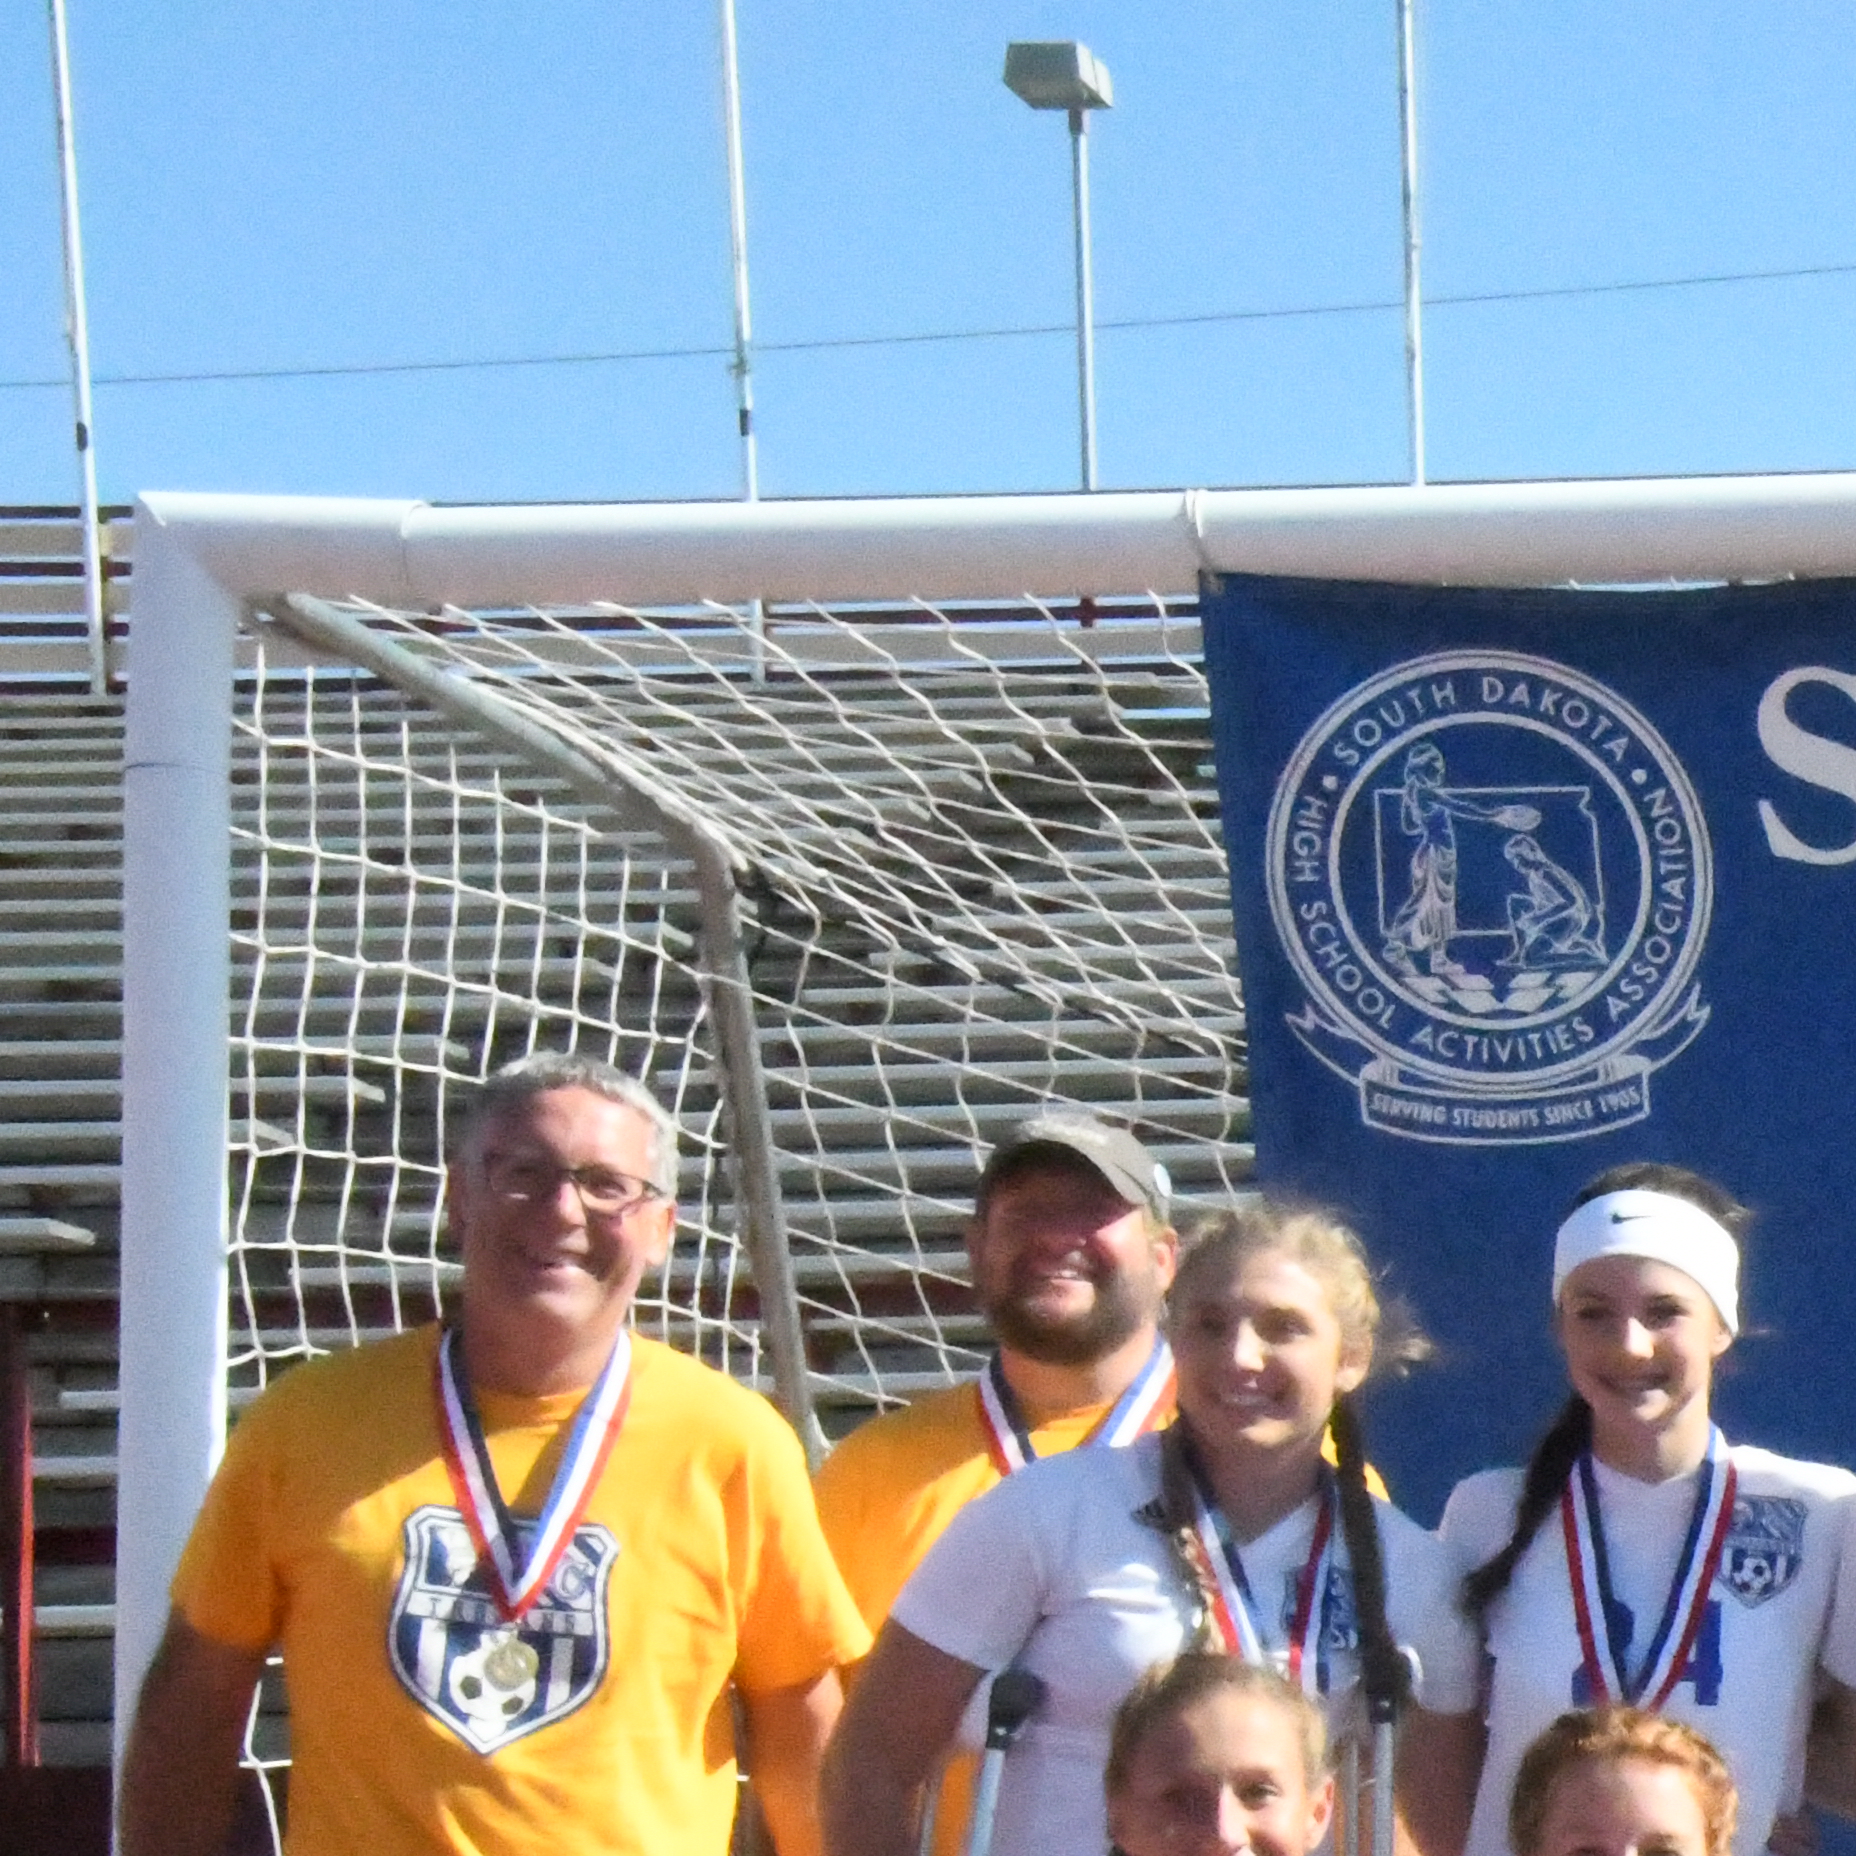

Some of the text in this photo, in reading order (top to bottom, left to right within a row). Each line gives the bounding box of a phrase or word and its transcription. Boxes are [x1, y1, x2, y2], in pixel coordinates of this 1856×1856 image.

[1333, 675, 1632, 768] SOUTH DAKOTA
[1292, 784, 1687, 1063] HIGH SCHOOL ACTIVITIES ASSOCIATION
[1453, 1108, 1539, 1129] STUDENTS
[1544, 1100, 1594, 1126] SINCE
